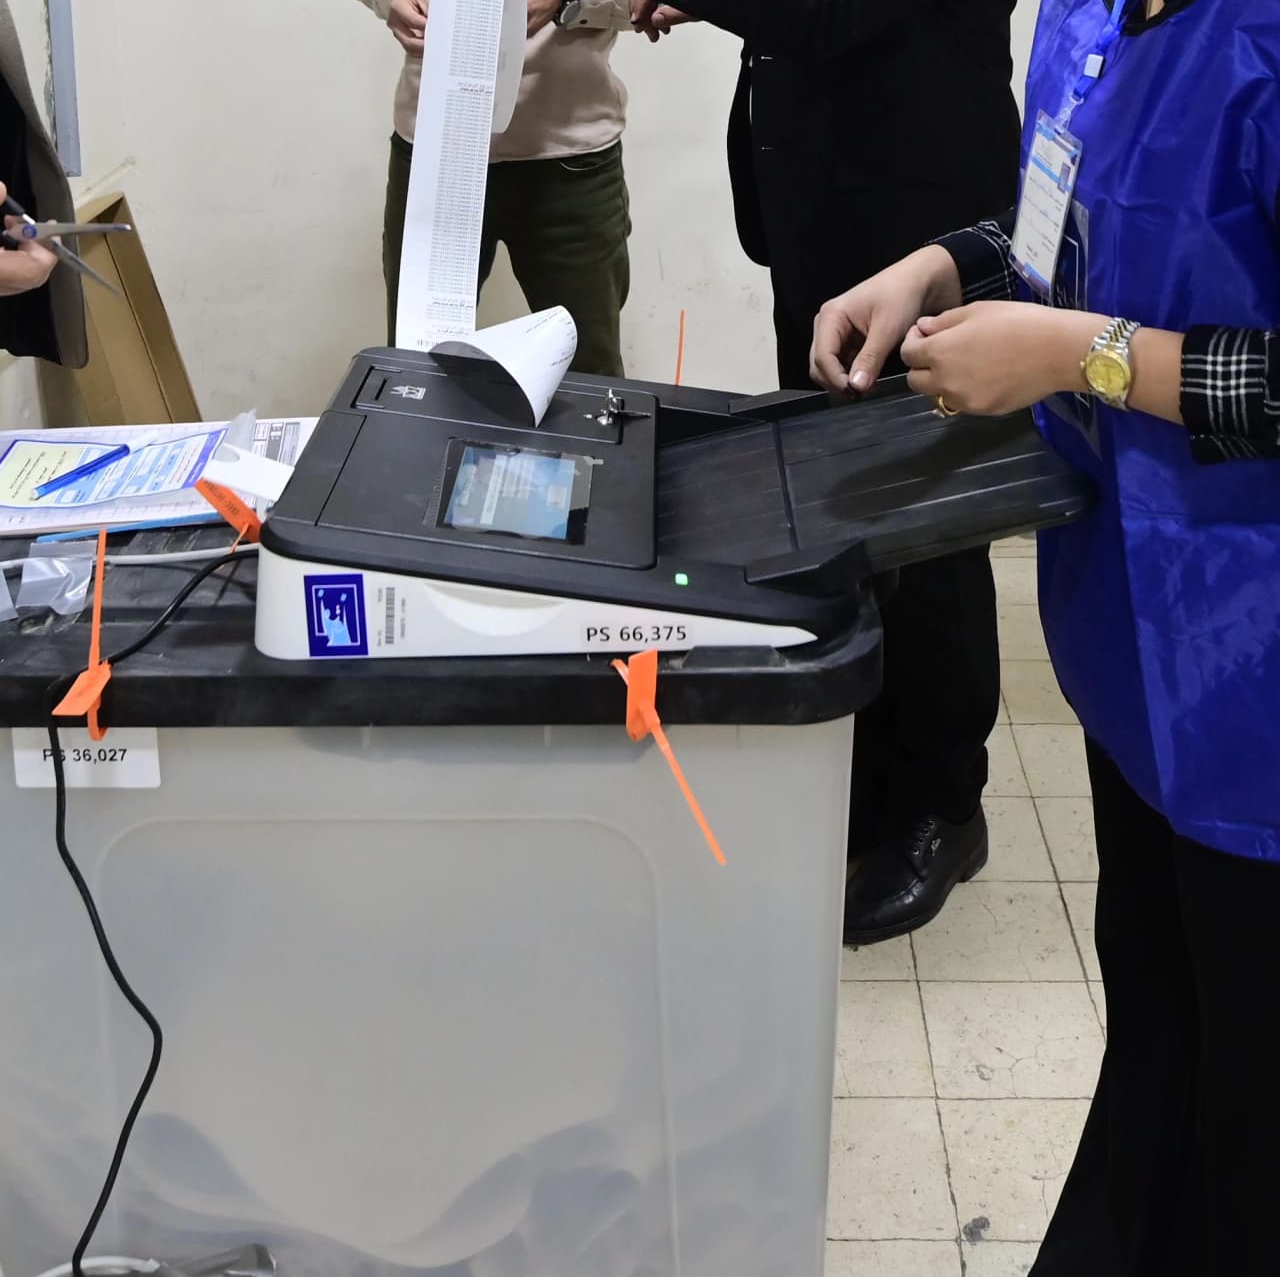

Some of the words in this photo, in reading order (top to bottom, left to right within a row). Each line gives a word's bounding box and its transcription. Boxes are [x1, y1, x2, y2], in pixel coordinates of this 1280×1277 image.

[586, 626, 610, 642] PS
[619, 625, 687, 643] 66,375
[72, 748, 128, 765] 36,027
